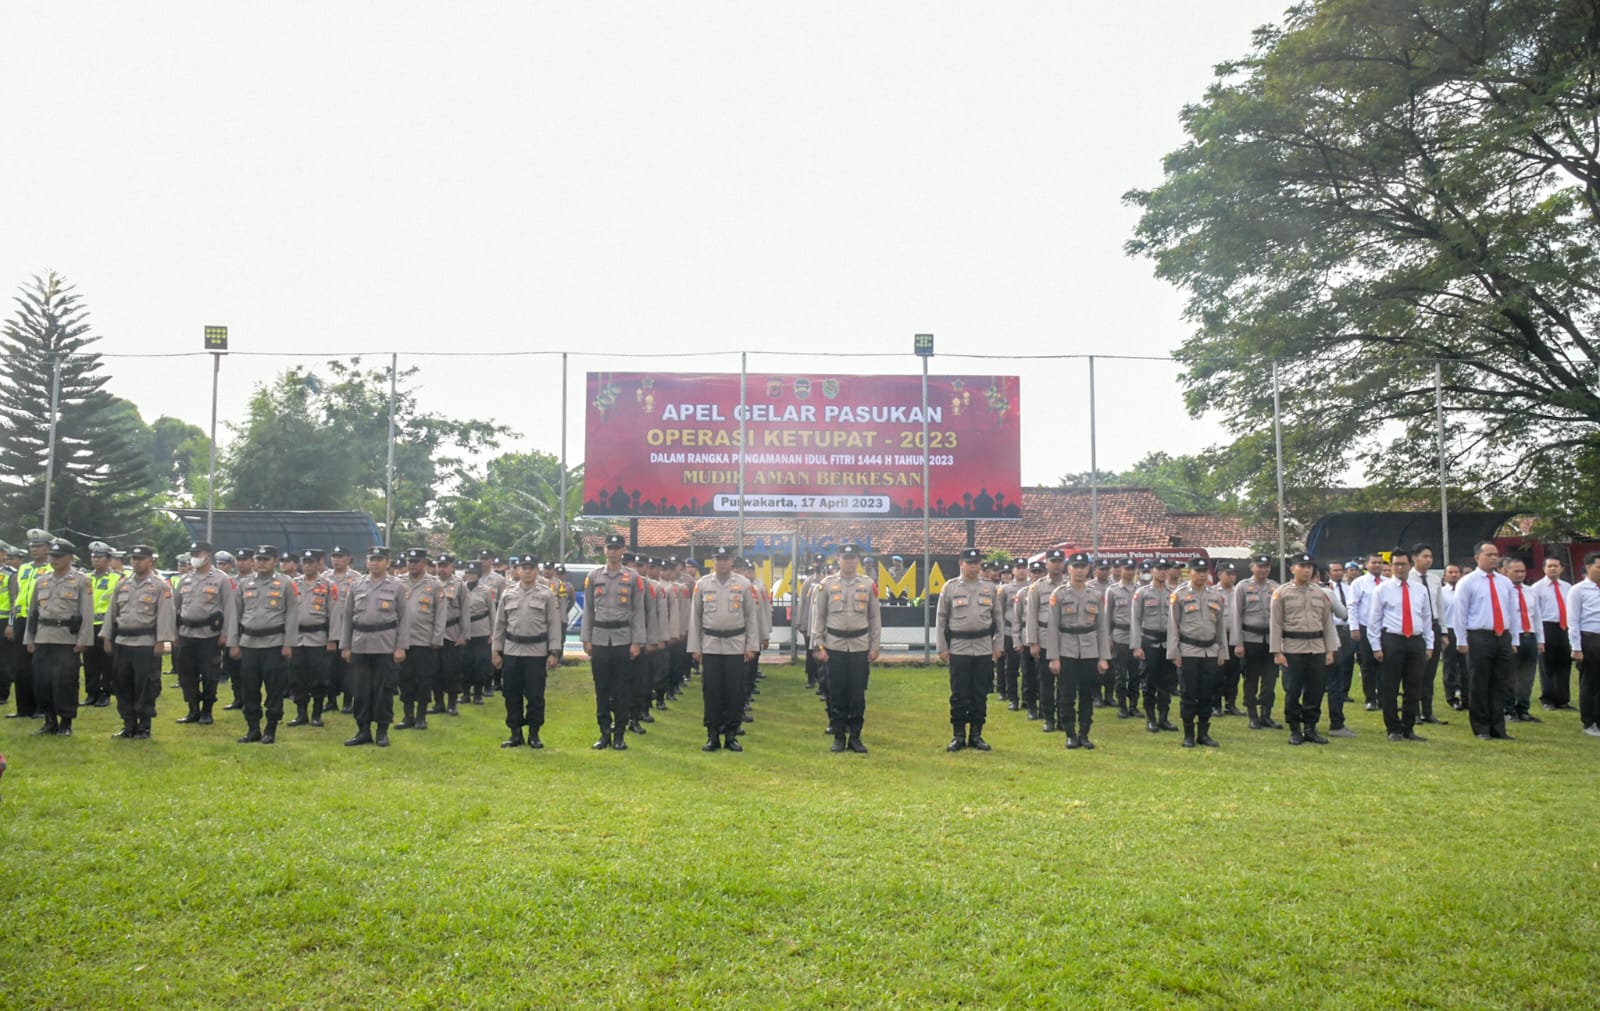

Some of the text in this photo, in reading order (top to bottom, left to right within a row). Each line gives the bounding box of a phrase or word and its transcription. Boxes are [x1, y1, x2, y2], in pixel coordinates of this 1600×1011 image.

[662, 404, 942, 423] APEL GELAR PASUKAN
[647, 429, 754, 447] OPERASI
[764, 430, 877, 448] KETUPAT
[900, 431, 958, 448] 2023
[650, 453, 954, 466] DALAM RANGKA PNGAMANAN IDUL FITRI 1444 H TAHUN 2023
[752, 471, 810, 485] AMAN
[816, 471, 921, 486] BERKESAN
[801, 498, 816, 508] 17
[819, 498, 849, 509] April
[851, 498, 884, 508] 2023
